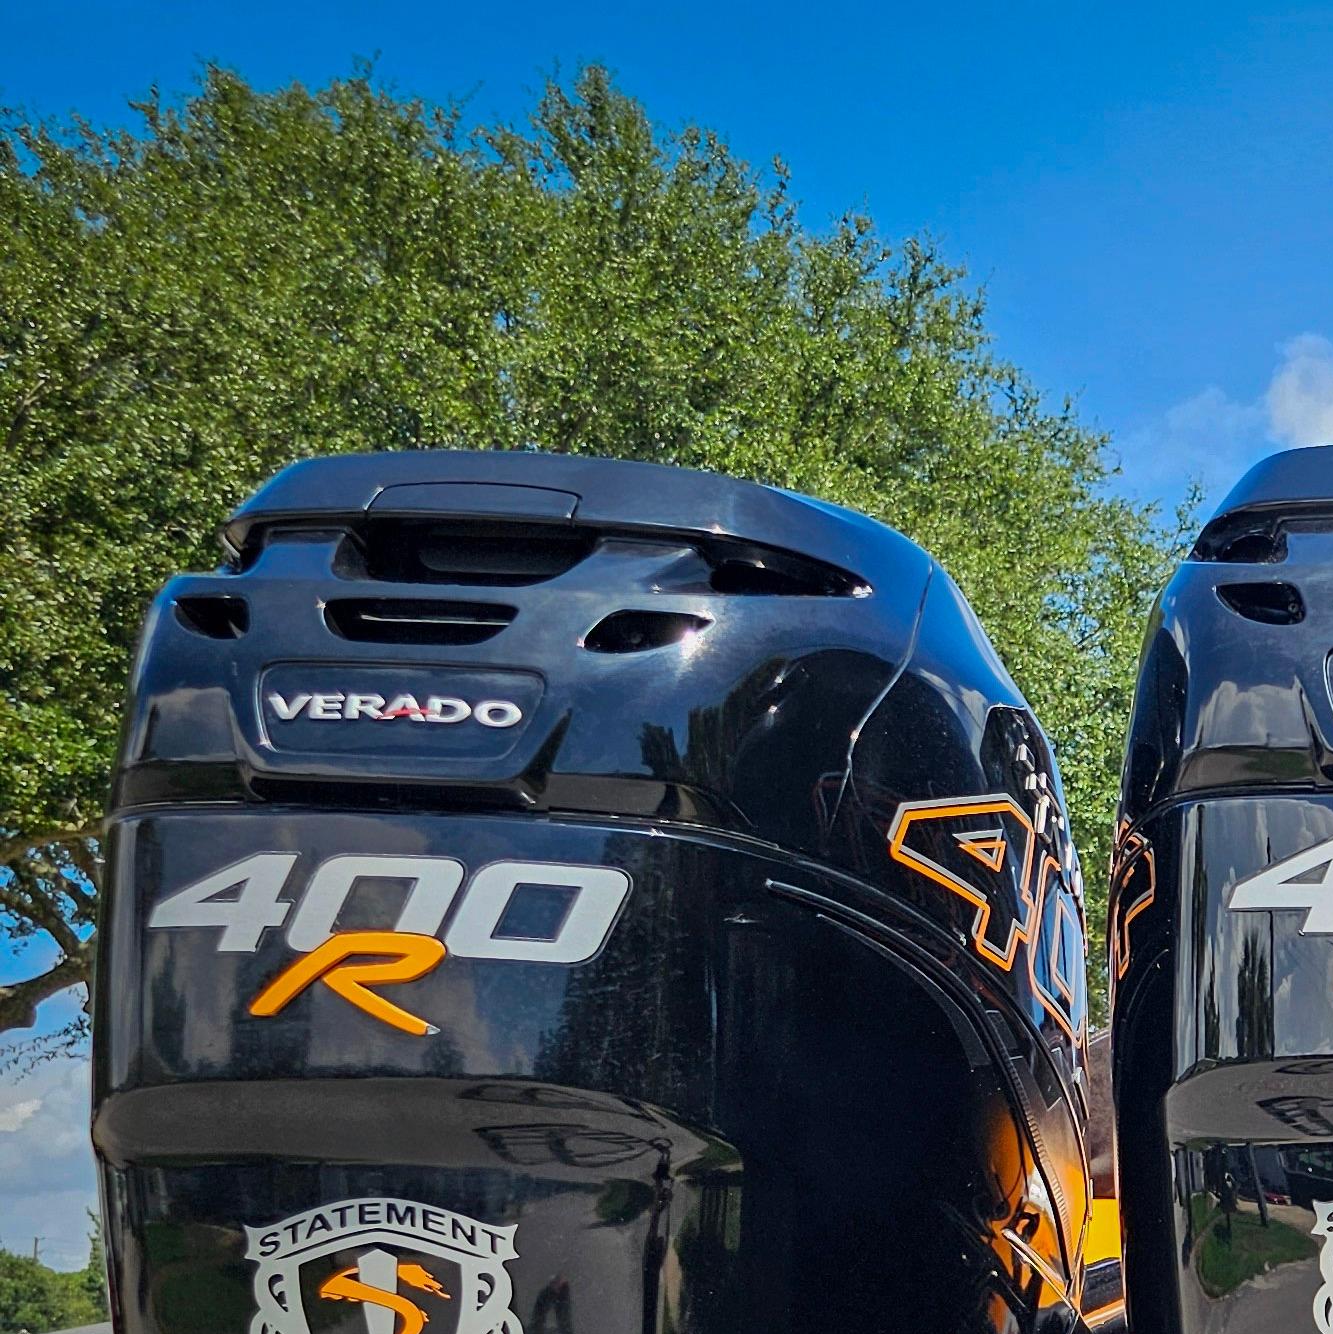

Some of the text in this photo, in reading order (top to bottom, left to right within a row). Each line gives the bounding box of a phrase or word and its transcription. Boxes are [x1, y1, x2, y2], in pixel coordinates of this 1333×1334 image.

[267, 692, 523, 728] VERADO
[149, 851, 632, 964] 400
[248, 931, 440, 1036] R
[258, 1201, 507, 1257] STATEMENT
